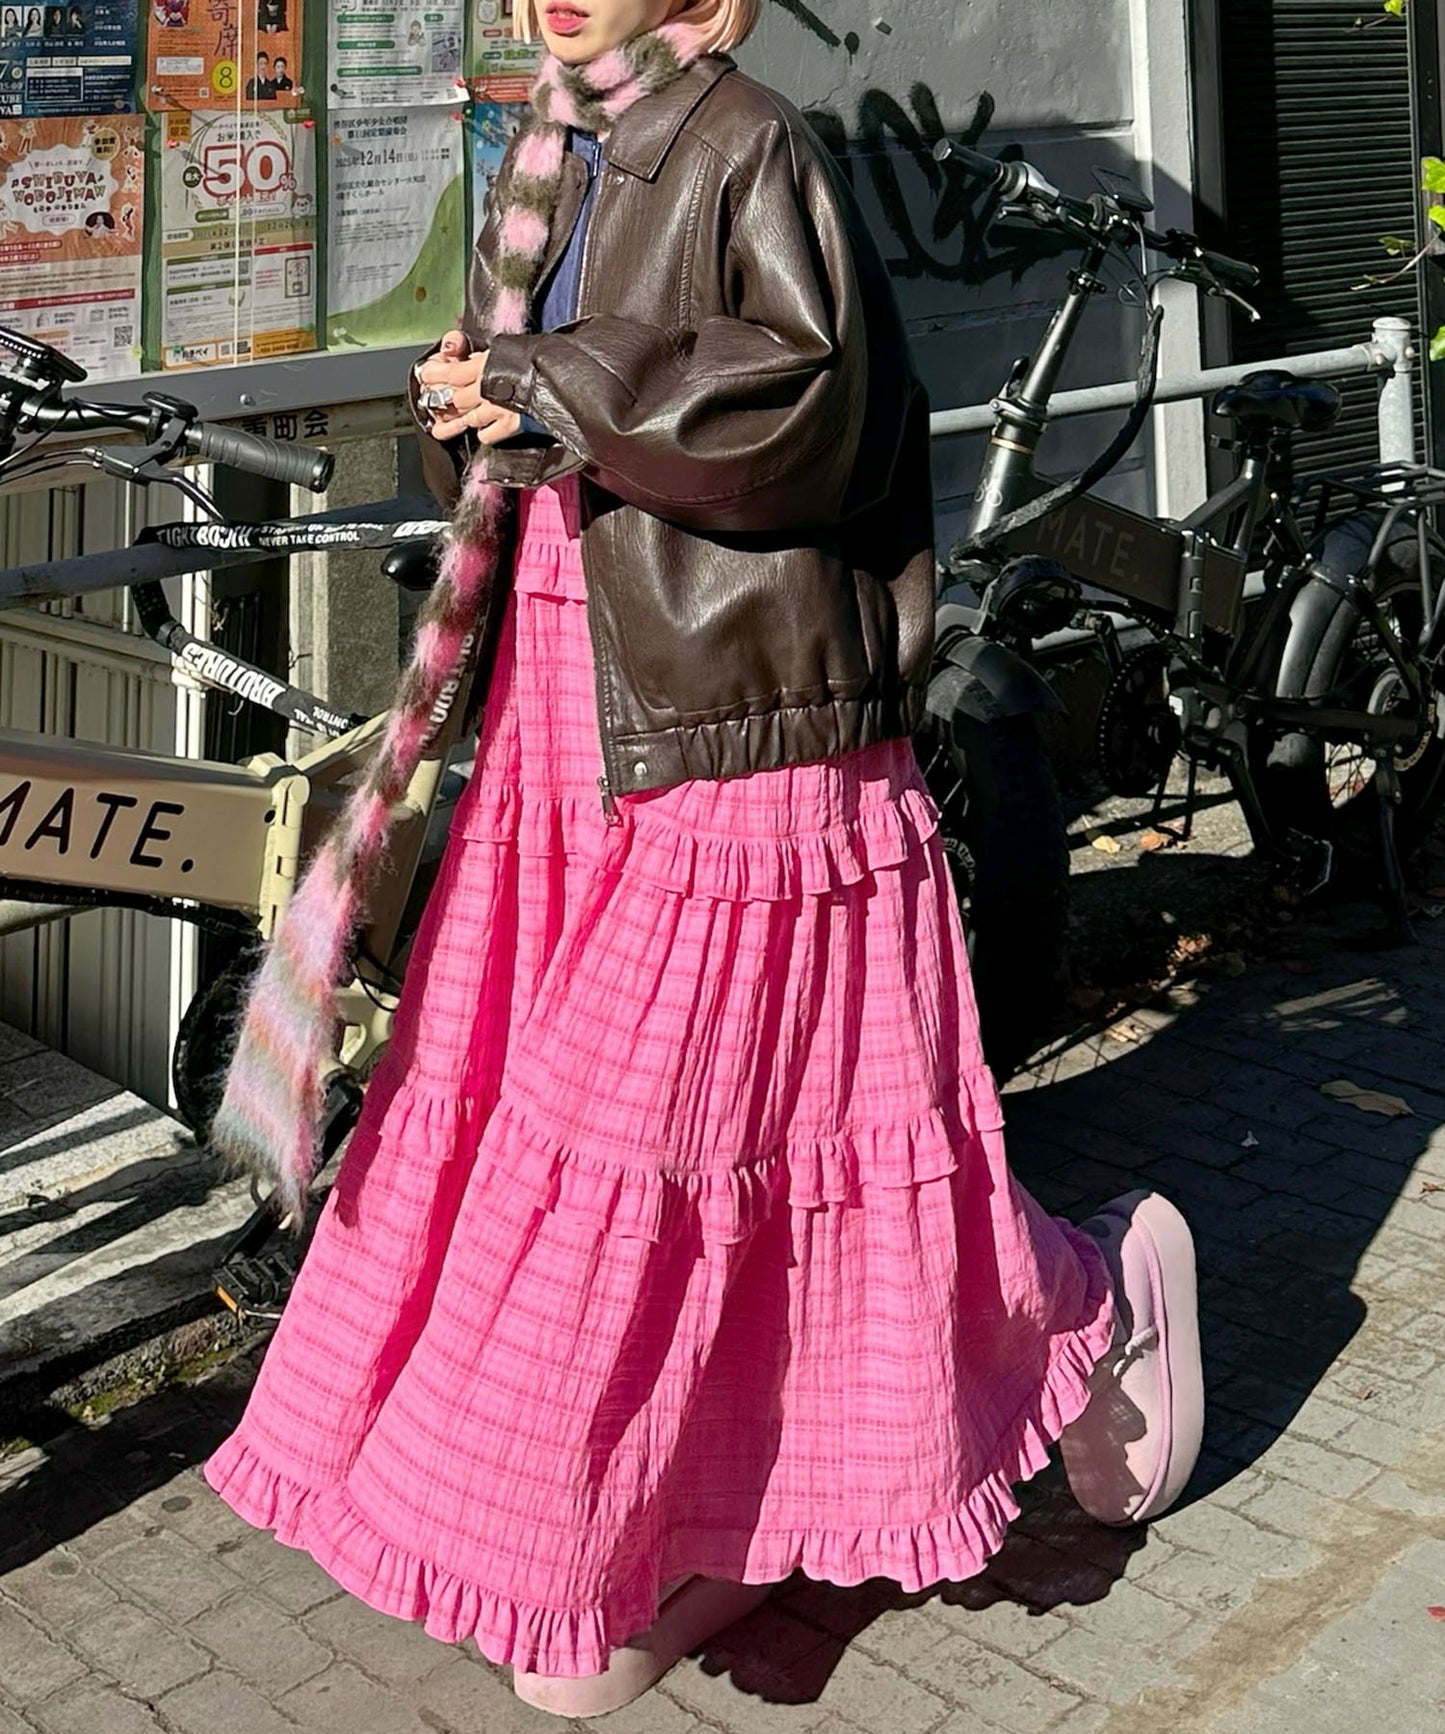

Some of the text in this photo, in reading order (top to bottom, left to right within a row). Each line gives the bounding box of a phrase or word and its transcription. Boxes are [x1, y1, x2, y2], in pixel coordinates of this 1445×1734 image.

[219, 67, 233, 88] 8
[259, 531, 361, 547] NEVER TAKE CONTROL
[1035, 507, 1141, 583] MATE.
